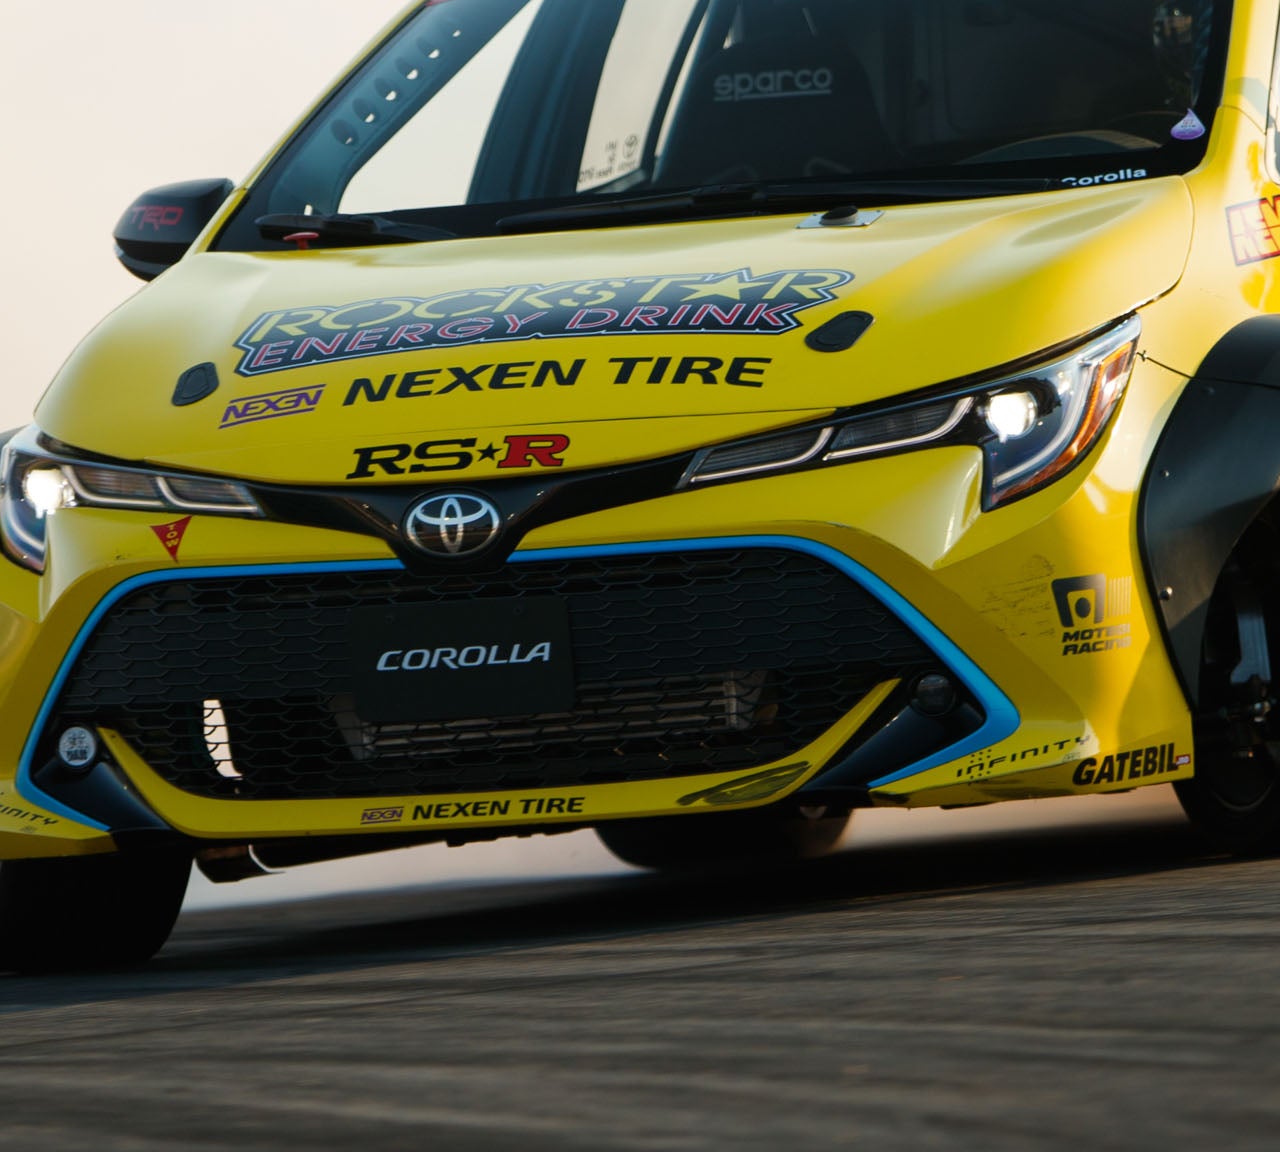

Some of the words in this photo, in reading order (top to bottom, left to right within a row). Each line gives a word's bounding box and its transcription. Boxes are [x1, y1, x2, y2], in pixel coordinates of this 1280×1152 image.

[713, 68, 833, 101] sparco
[1061, 168, 1148, 186] Corolla
[129, 205, 184, 231] TRD
[252, 311, 549, 367] ENERGY
[565, 302, 800, 330] DRINK
[341, 356, 587, 407] NEXEN
[607, 356, 773, 388] TIRE
[166, 522, 180, 548] TOW
[376, 641, 552, 671] COROLLA
[1061, 635, 1133, 656] RACING
[957, 734, 1091, 778] INFINITY
[1072, 742, 1180, 786] GATEBIL
[412, 800, 511, 821] NEXEN
[519, 796, 586, 815] TIRE
